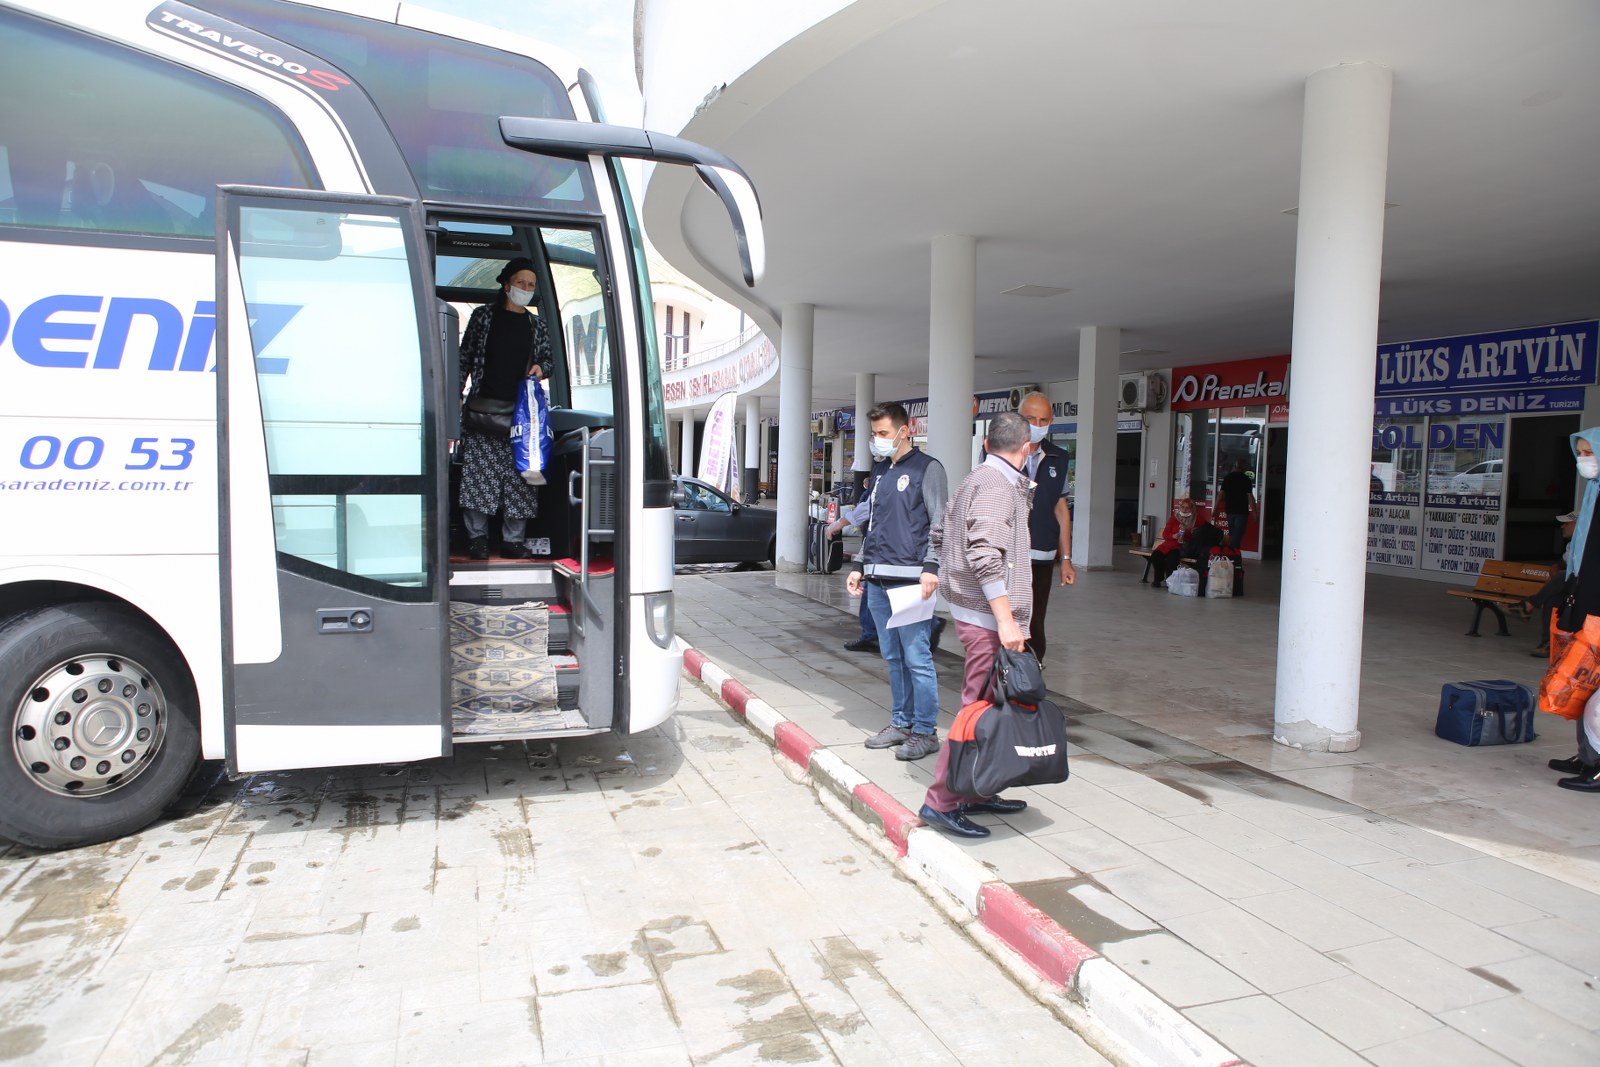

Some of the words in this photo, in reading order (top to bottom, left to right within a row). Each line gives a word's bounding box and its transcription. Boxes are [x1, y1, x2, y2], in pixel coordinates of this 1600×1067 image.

[160, 11, 308, 75] TRAVEGO
[452, 240, 490, 248] TRAVEGO
[1379, 344, 1450, 385] LÜKS
[1456, 327, 1587, 379] ARTVİN
[1389, 397, 1452, 415] LÜKS
[1460, 392, 1546, 412] DENİZ
[1549, 400, 1580, 409] TURİZM
[19, 435, 105, 470] 00
[124, 437, 196, 470] 53
[1384, 493, 1419, 502] Artvin
[1427, 494, 1457, 505] Lüks
[1459, 496, 1499, 506] Artvin
[1470, 530, 1496, 543] SAKARYA
[1468, 543, 1495, 559] İSTANBUL
[1440, 559, 1458, 571] AFYON
